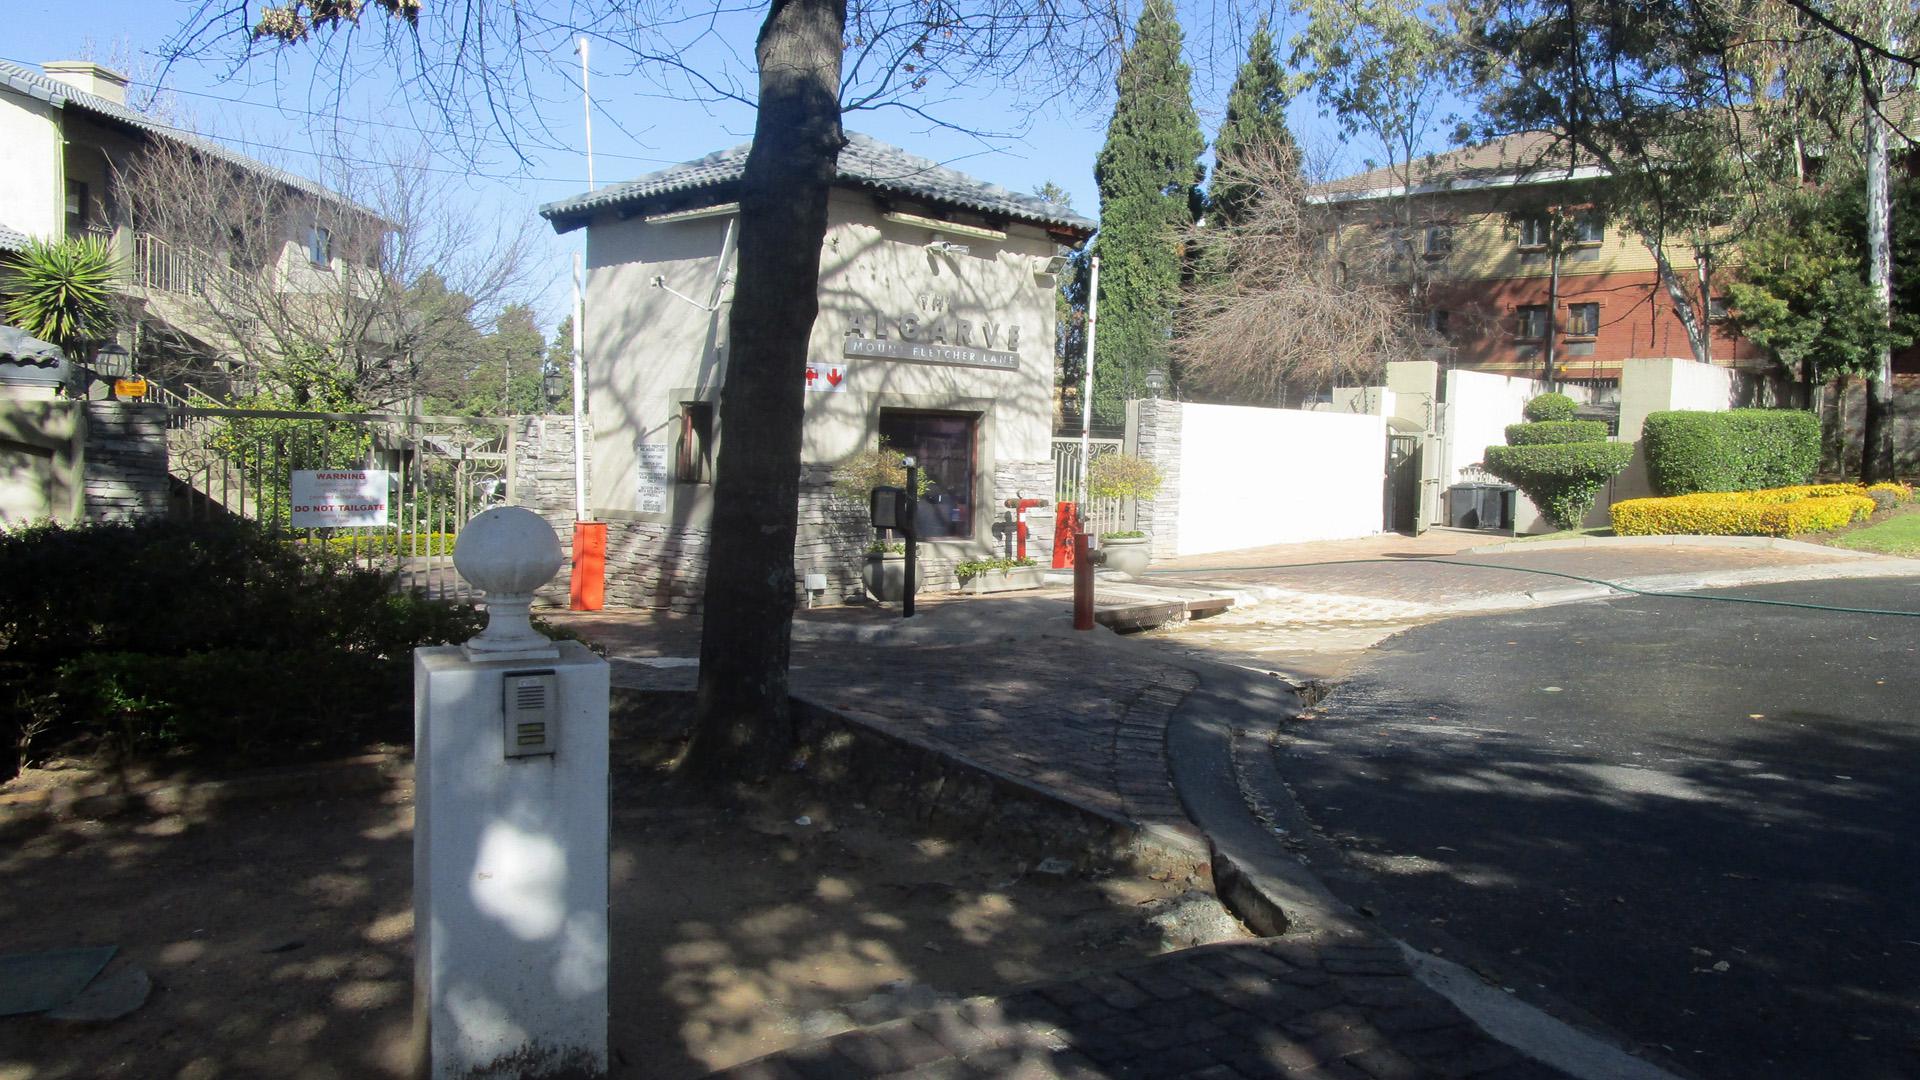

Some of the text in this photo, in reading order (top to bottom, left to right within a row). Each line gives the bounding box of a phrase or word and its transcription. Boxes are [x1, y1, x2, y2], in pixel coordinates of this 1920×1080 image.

[844, 310, 1021, 351] ALGARVE
[853, 341, 1015, 365] MOUN FLETCHER LANE
[338, 504, 385, 512] TAILGATE
